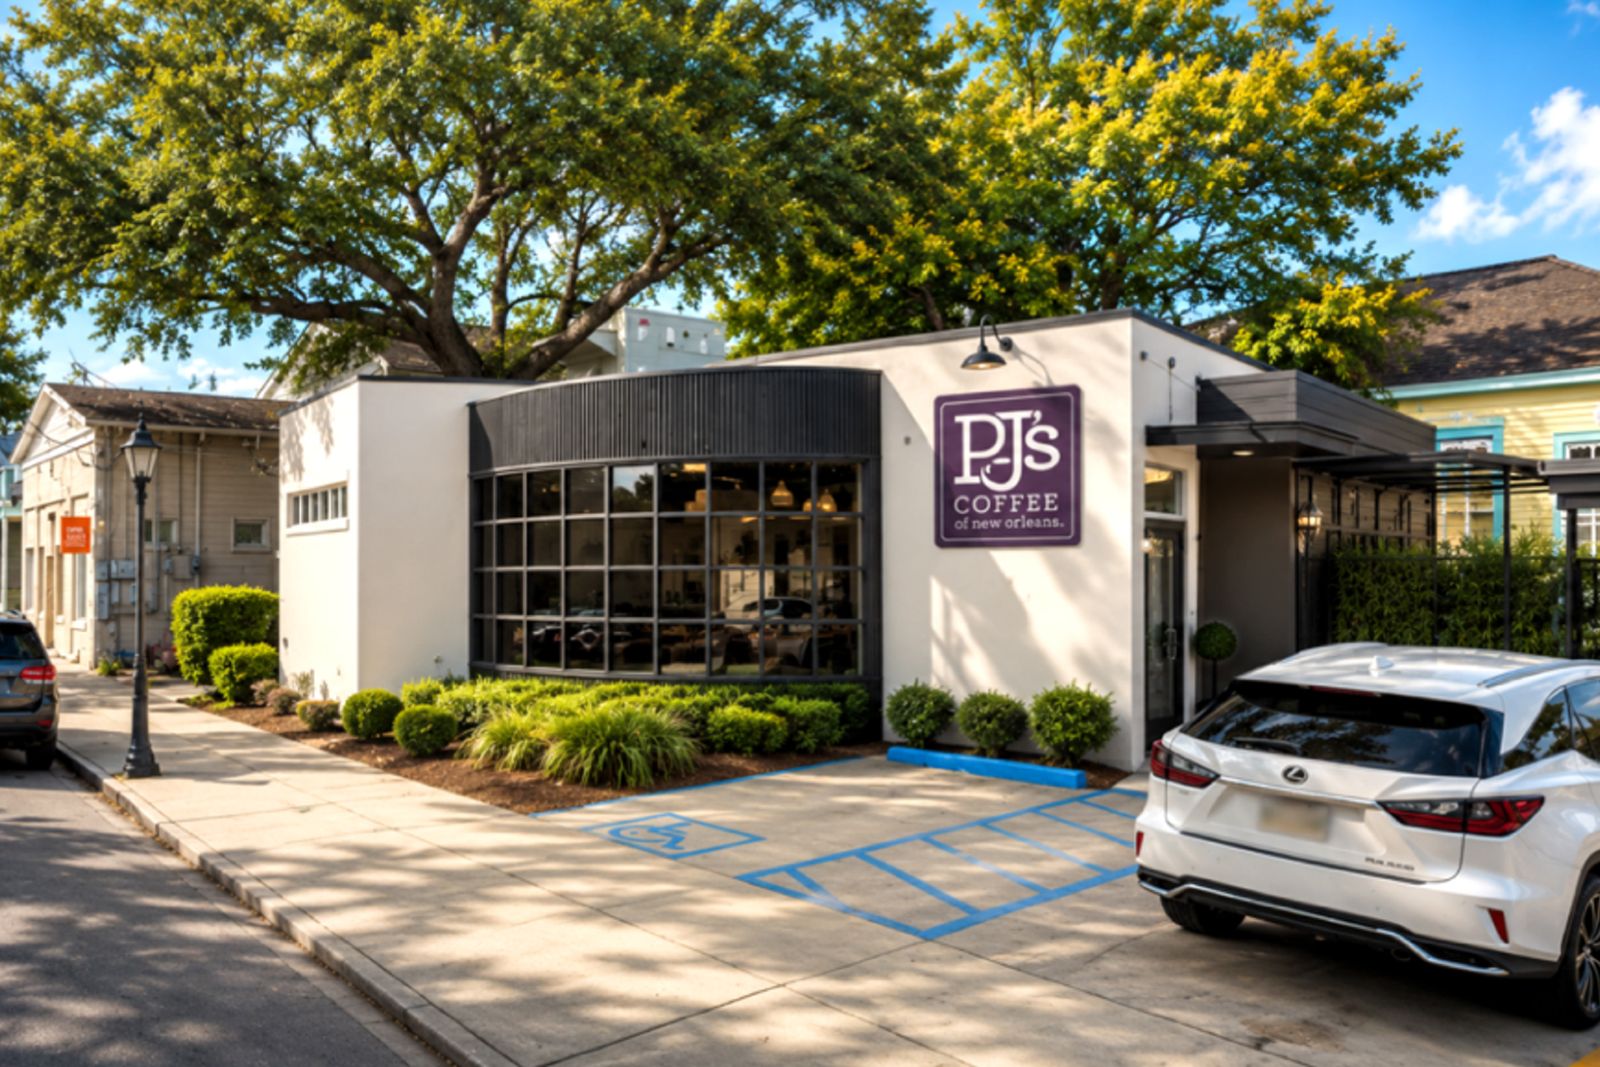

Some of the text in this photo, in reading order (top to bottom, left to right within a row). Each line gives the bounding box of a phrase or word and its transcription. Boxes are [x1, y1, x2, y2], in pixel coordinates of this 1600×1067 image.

[954, 410, 1061, 492] PJ's
[954, 493, 1059, 515] COFFEE
[954, 516, 1065, 530] of new orleans.
